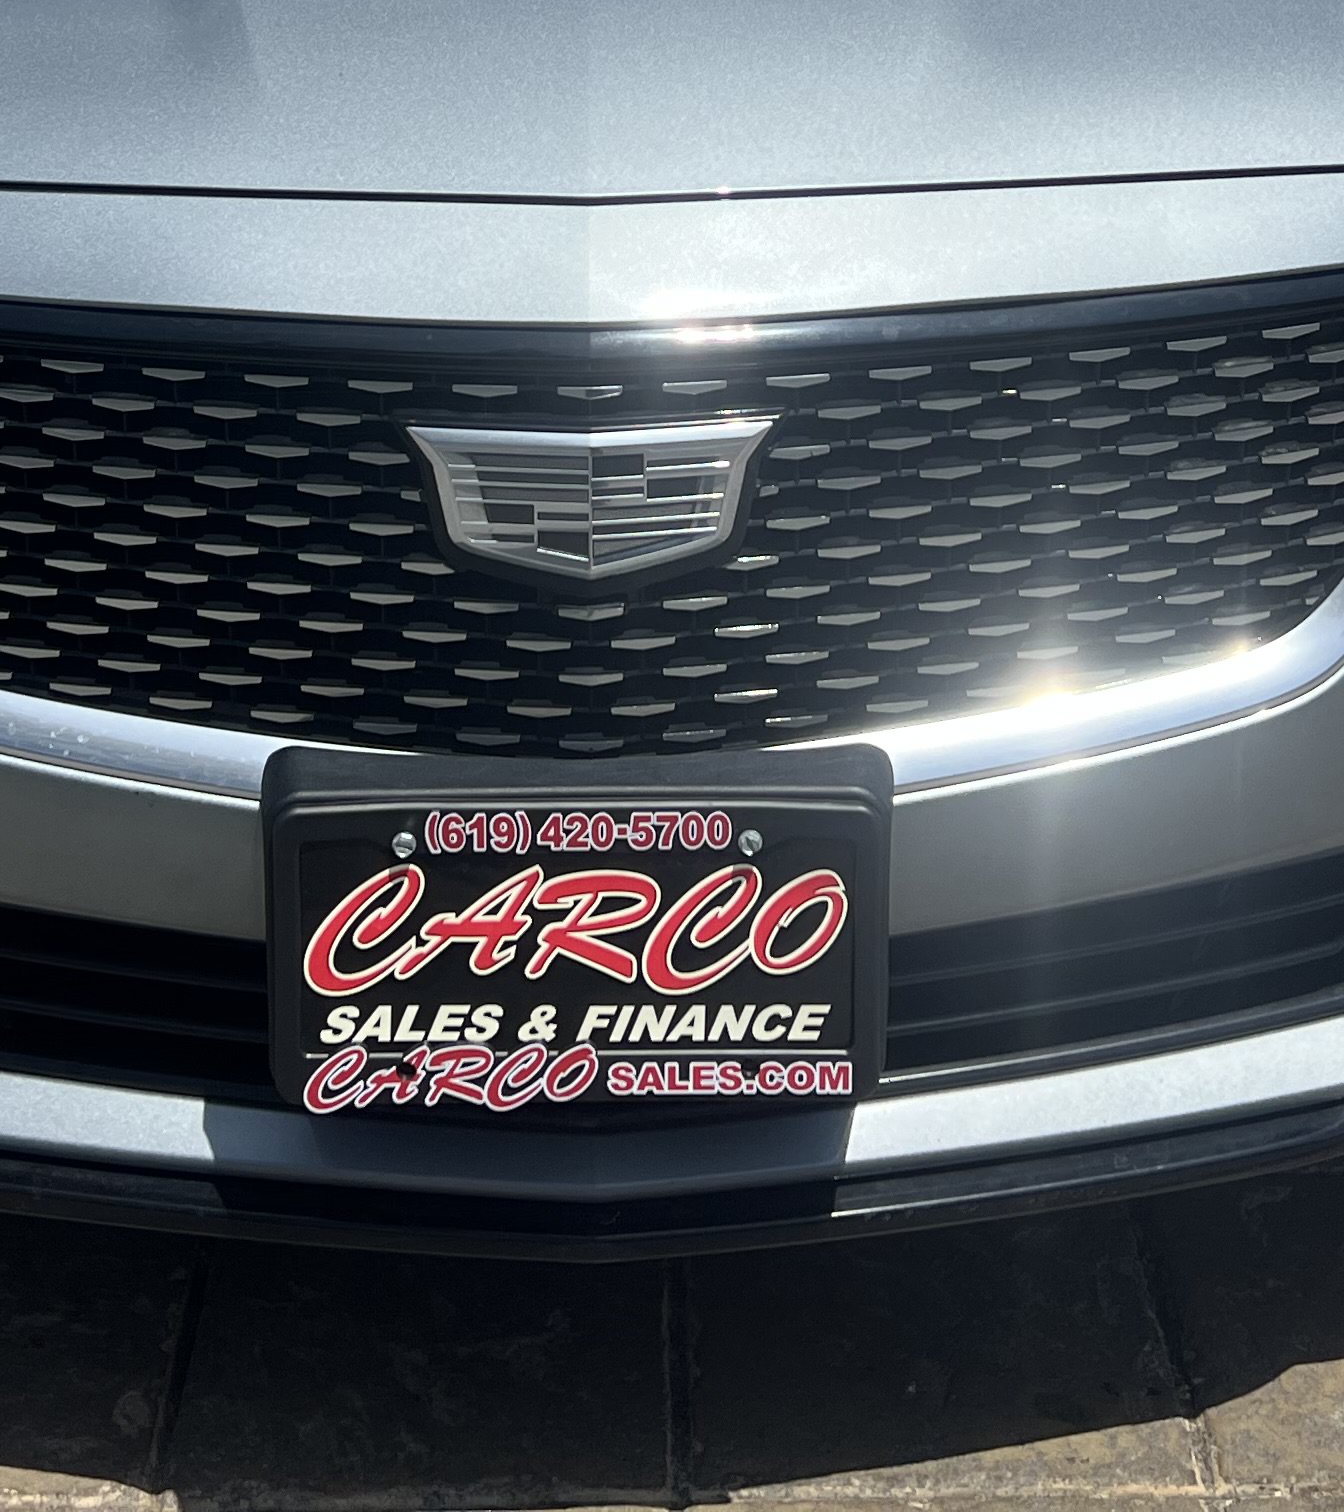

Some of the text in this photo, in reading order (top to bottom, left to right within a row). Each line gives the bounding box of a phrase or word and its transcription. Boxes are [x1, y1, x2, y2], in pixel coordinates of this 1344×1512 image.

[424, 810, 733, 853] (619) 420-5700
[304, 862, 849, 996] CARCO
[320, 1004, 832, 1043] SALES & FINANCE
[303, 1042, 854, 1114] CARCO SALES.COM
